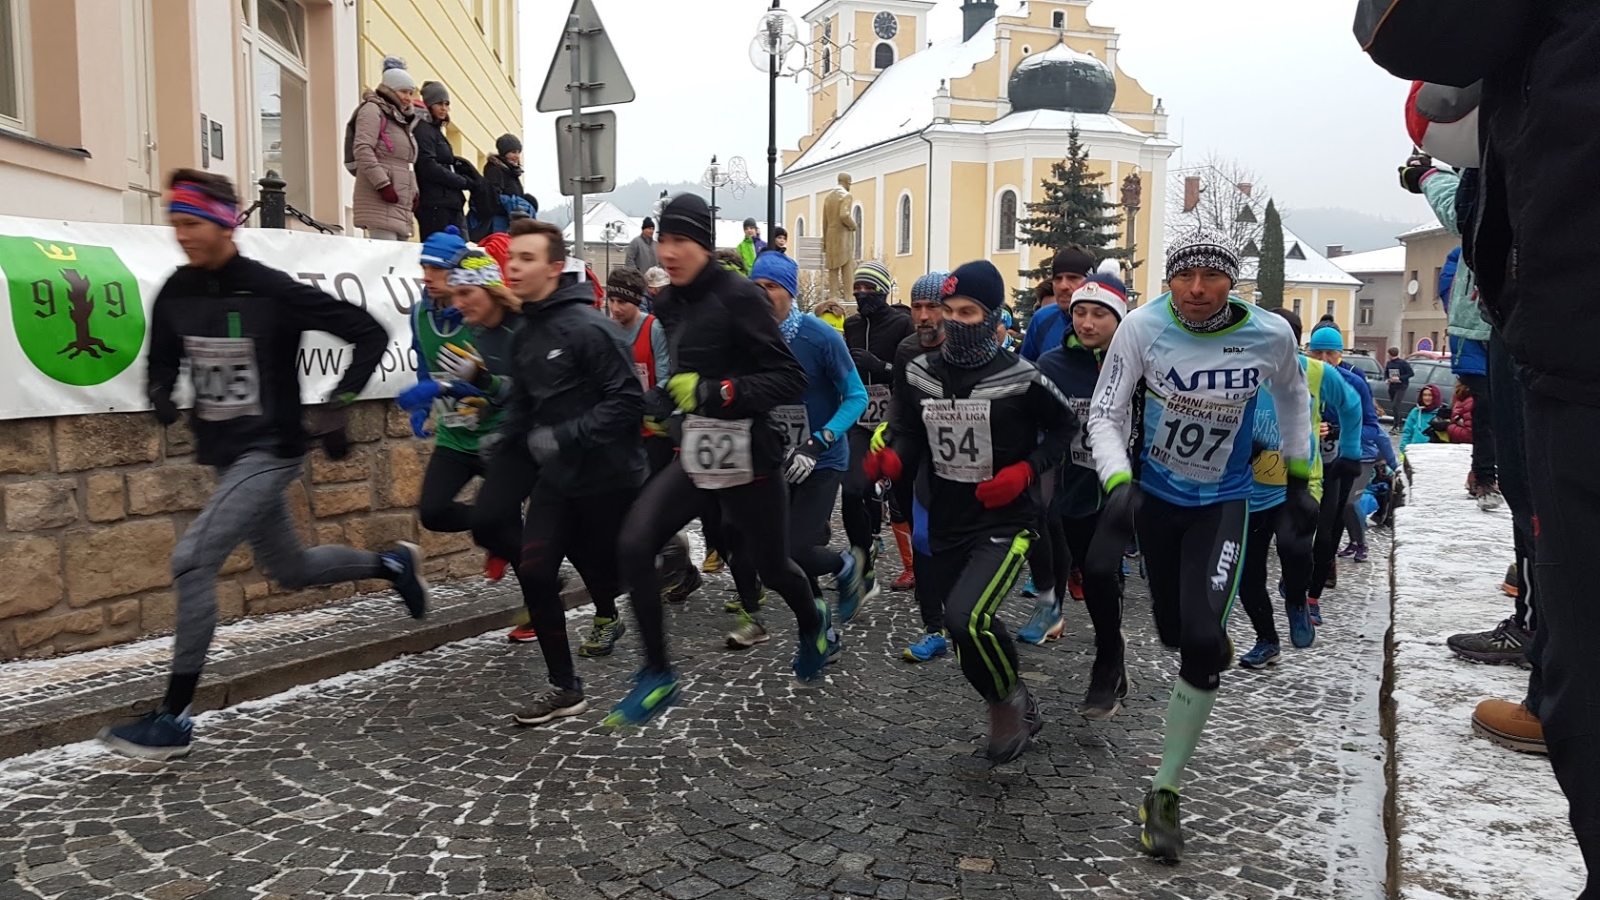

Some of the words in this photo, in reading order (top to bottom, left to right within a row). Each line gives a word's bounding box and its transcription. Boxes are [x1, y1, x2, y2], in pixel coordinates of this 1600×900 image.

[382, 266, 424, 315] Ú
[1165, 366, 1260, 392] ASTER
[858, 400, 890, 423] 28
[1071, 400, 1091, 408] ZIMN
[1170, 393, 1204, 408] ZIMNÍ
[965, 412, 987, 421] LIGA
[1216, 413, 1239, 425] LIGA
[697, 434, 738, 470] 62
[938, 426, 979, 463] 54
[1164, 418, 1232, 463] 197
